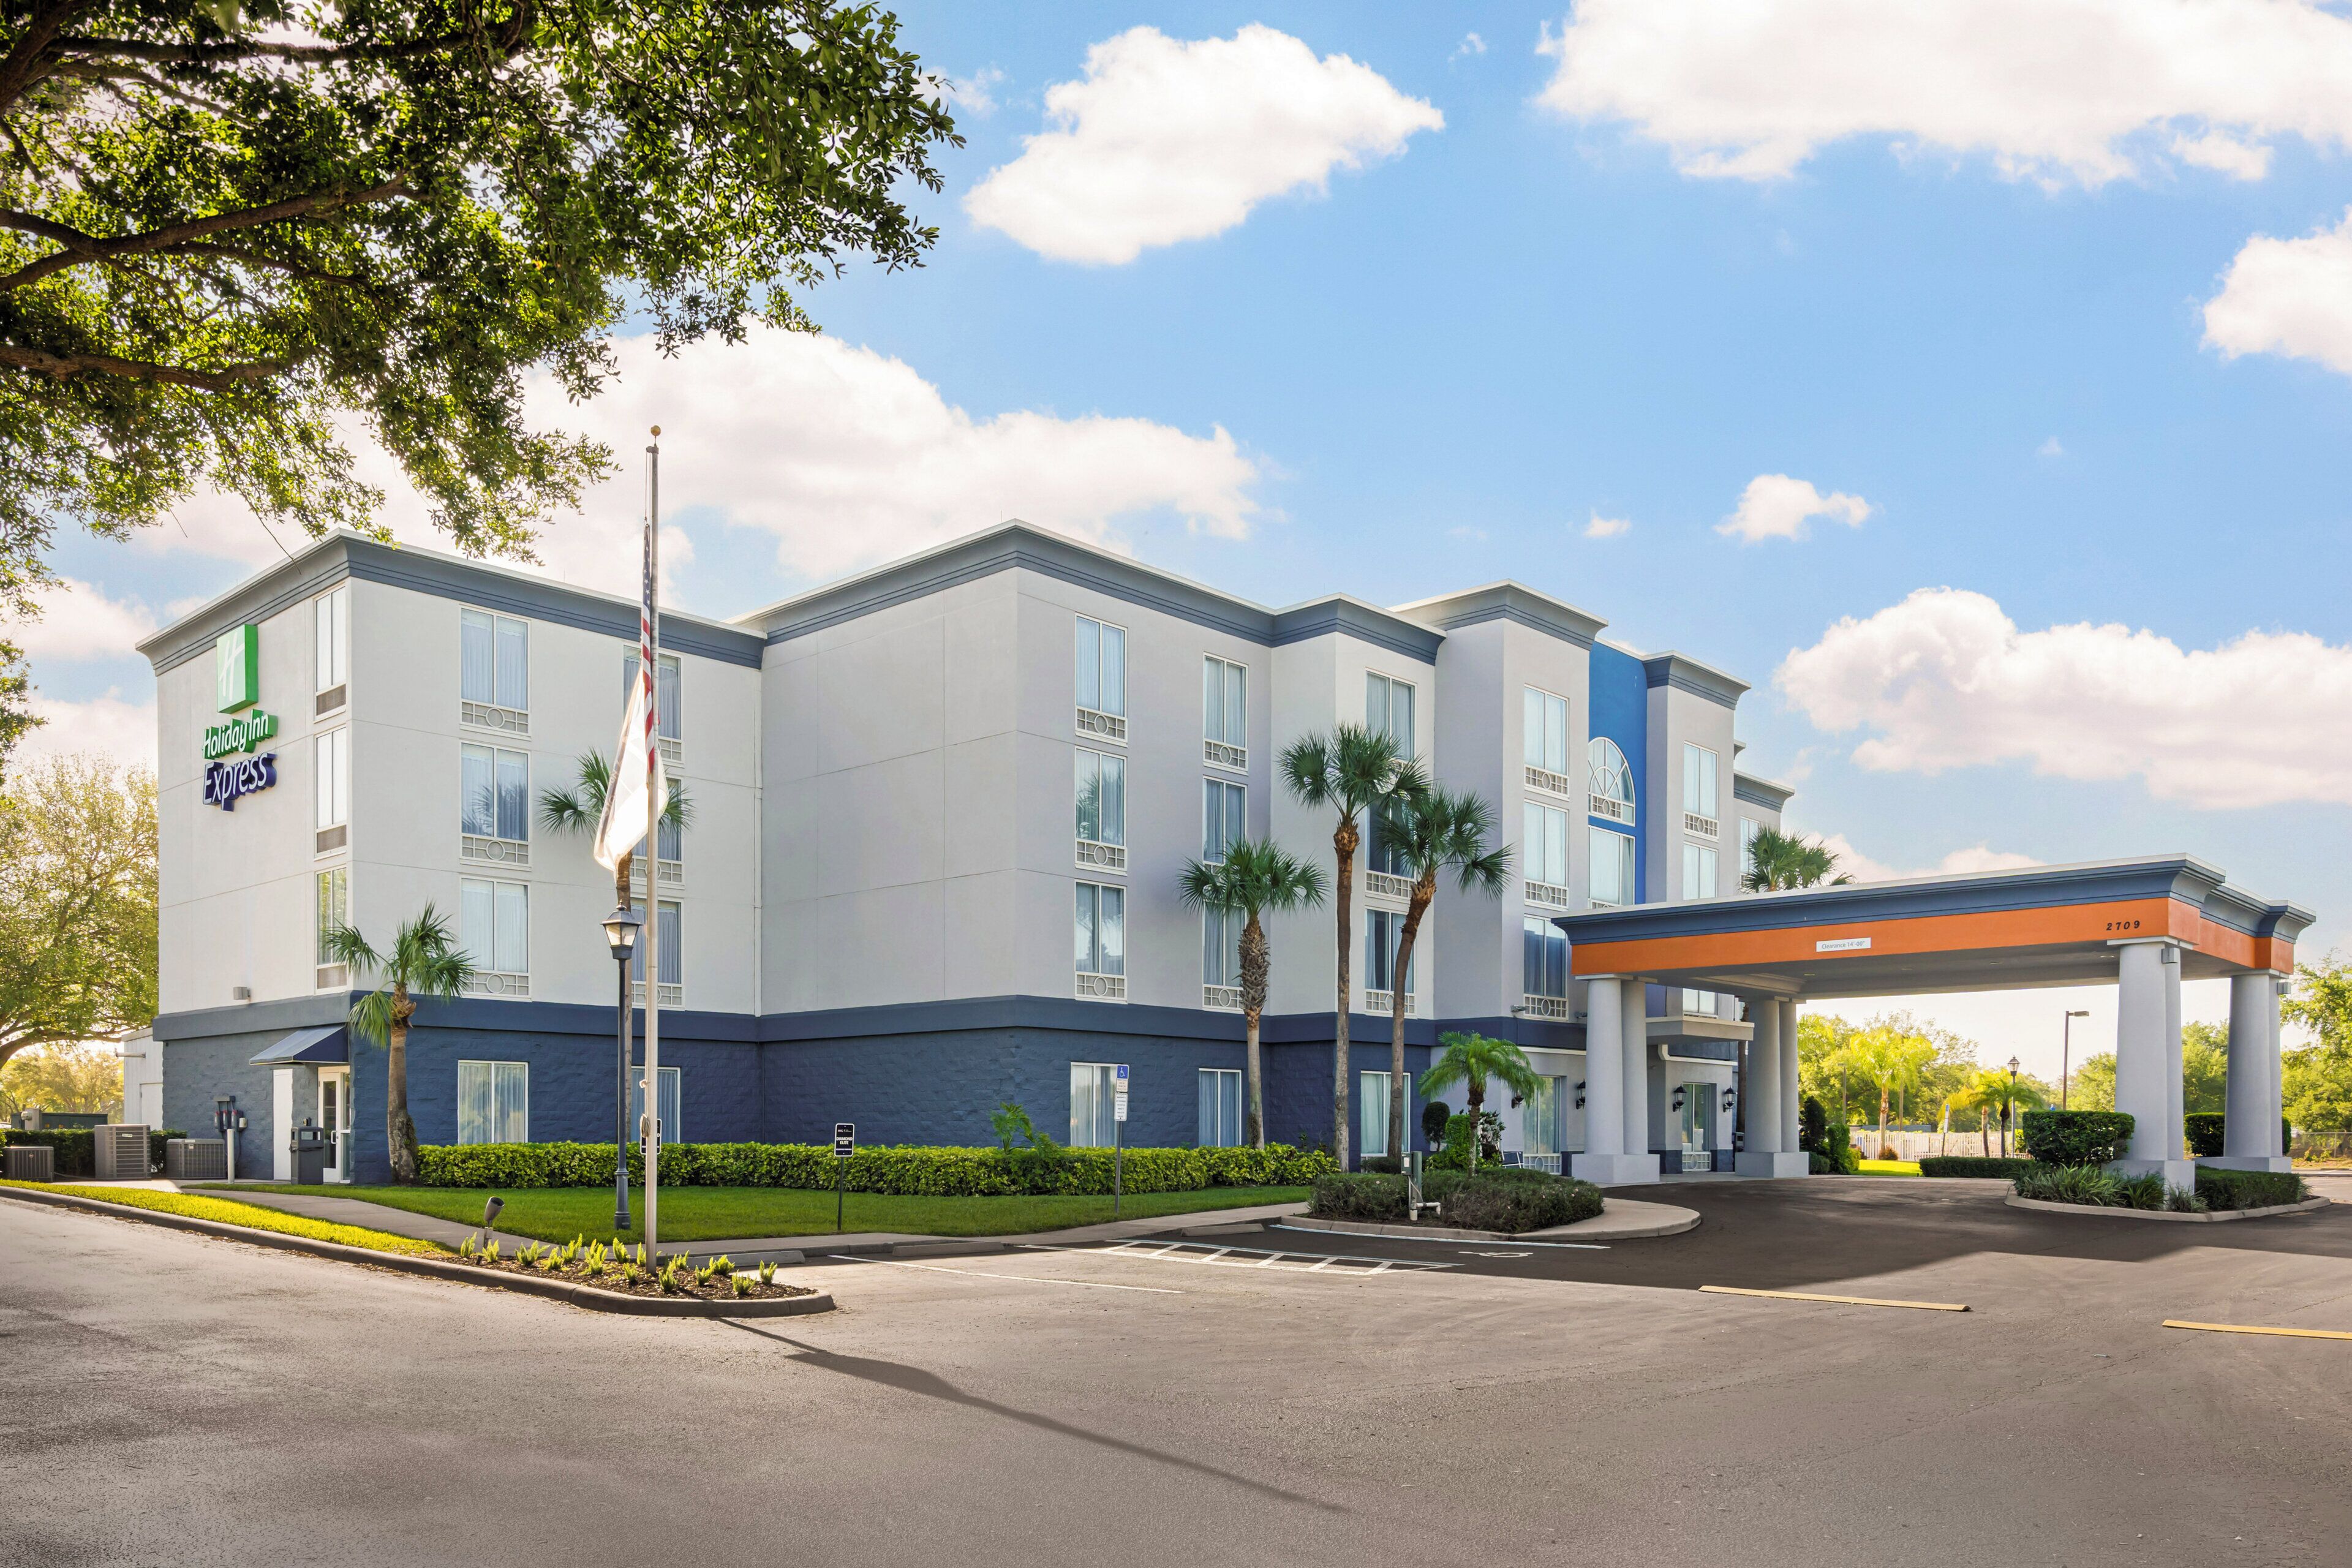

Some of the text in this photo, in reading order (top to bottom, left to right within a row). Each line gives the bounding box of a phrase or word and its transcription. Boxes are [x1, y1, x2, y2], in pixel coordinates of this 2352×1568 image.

[203, 709, 273, 758] Holiday Inn
[203, 752, 273, 811] Express
